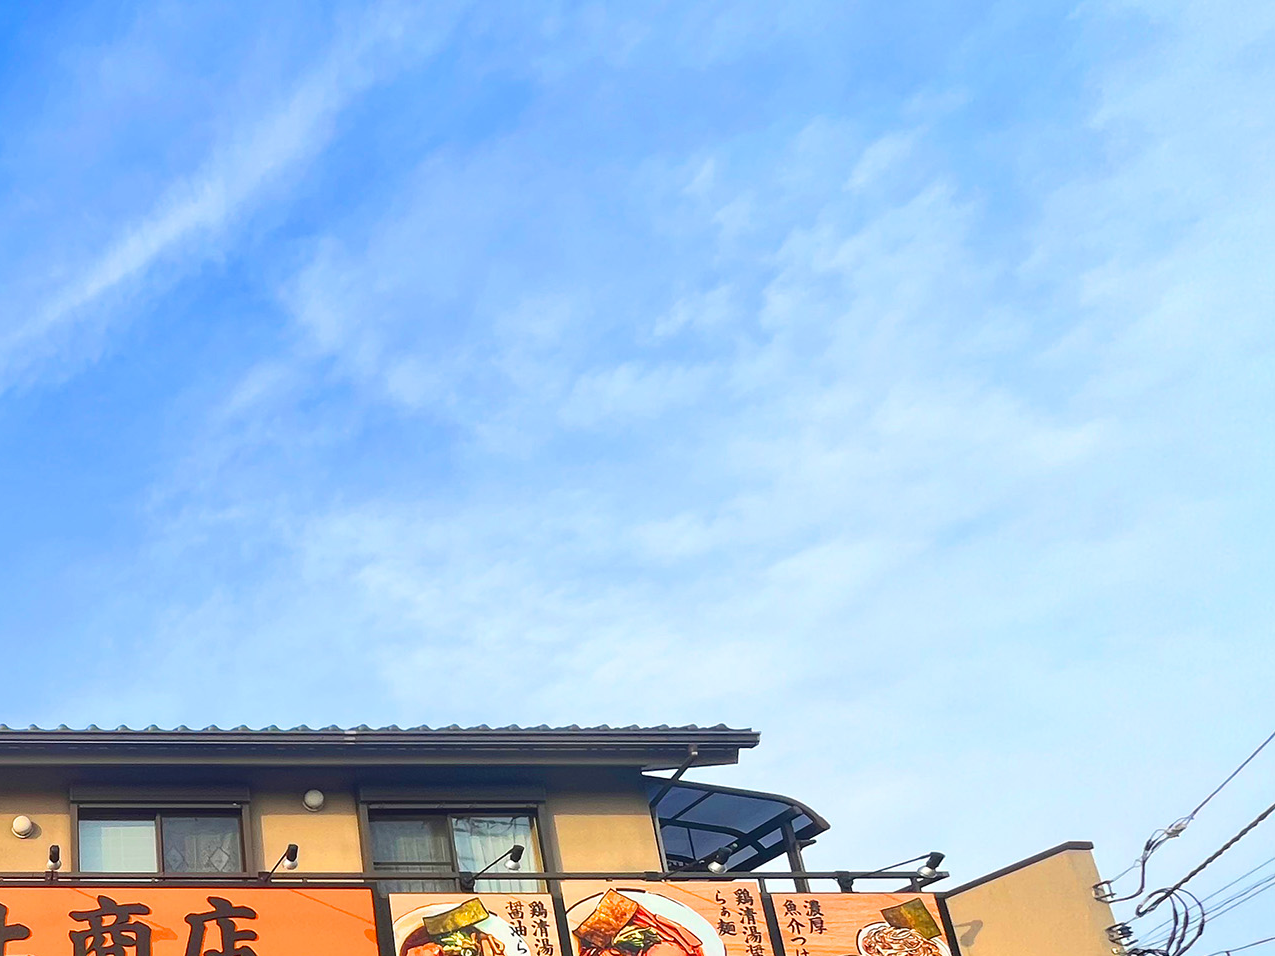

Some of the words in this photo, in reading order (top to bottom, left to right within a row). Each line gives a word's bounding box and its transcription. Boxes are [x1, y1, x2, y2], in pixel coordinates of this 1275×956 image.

[714, 890, 737, 936] らぁ麺
[804, 900, 827, 934] 濃厚
